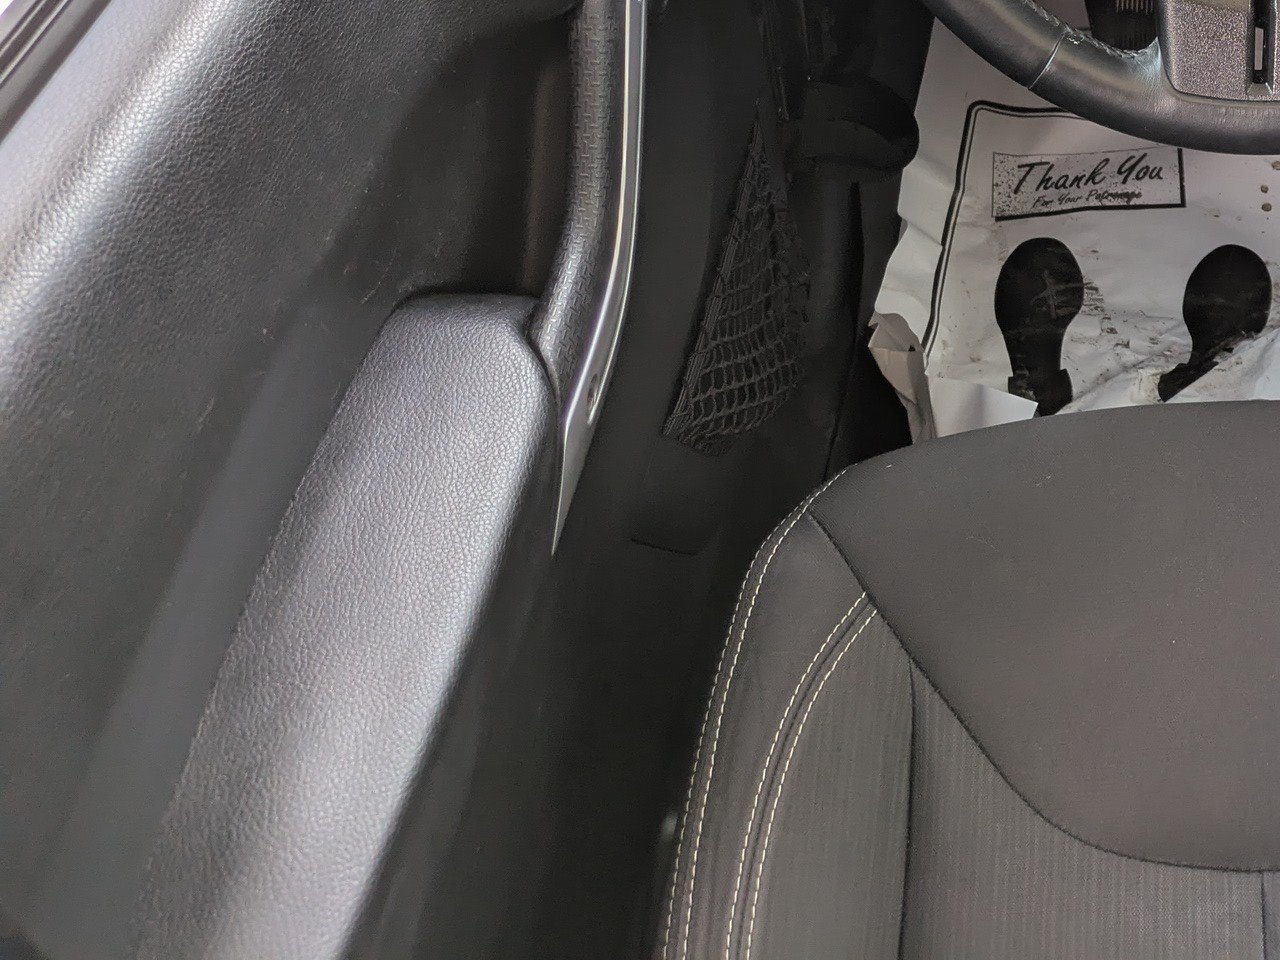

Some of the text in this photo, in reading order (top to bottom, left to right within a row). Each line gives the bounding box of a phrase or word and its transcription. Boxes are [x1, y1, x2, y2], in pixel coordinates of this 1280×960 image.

[1013, 152, 1163, 195] Thank You
[1032, 195, 1054, 208] For
[1057, 192, 1082, 206] Your
